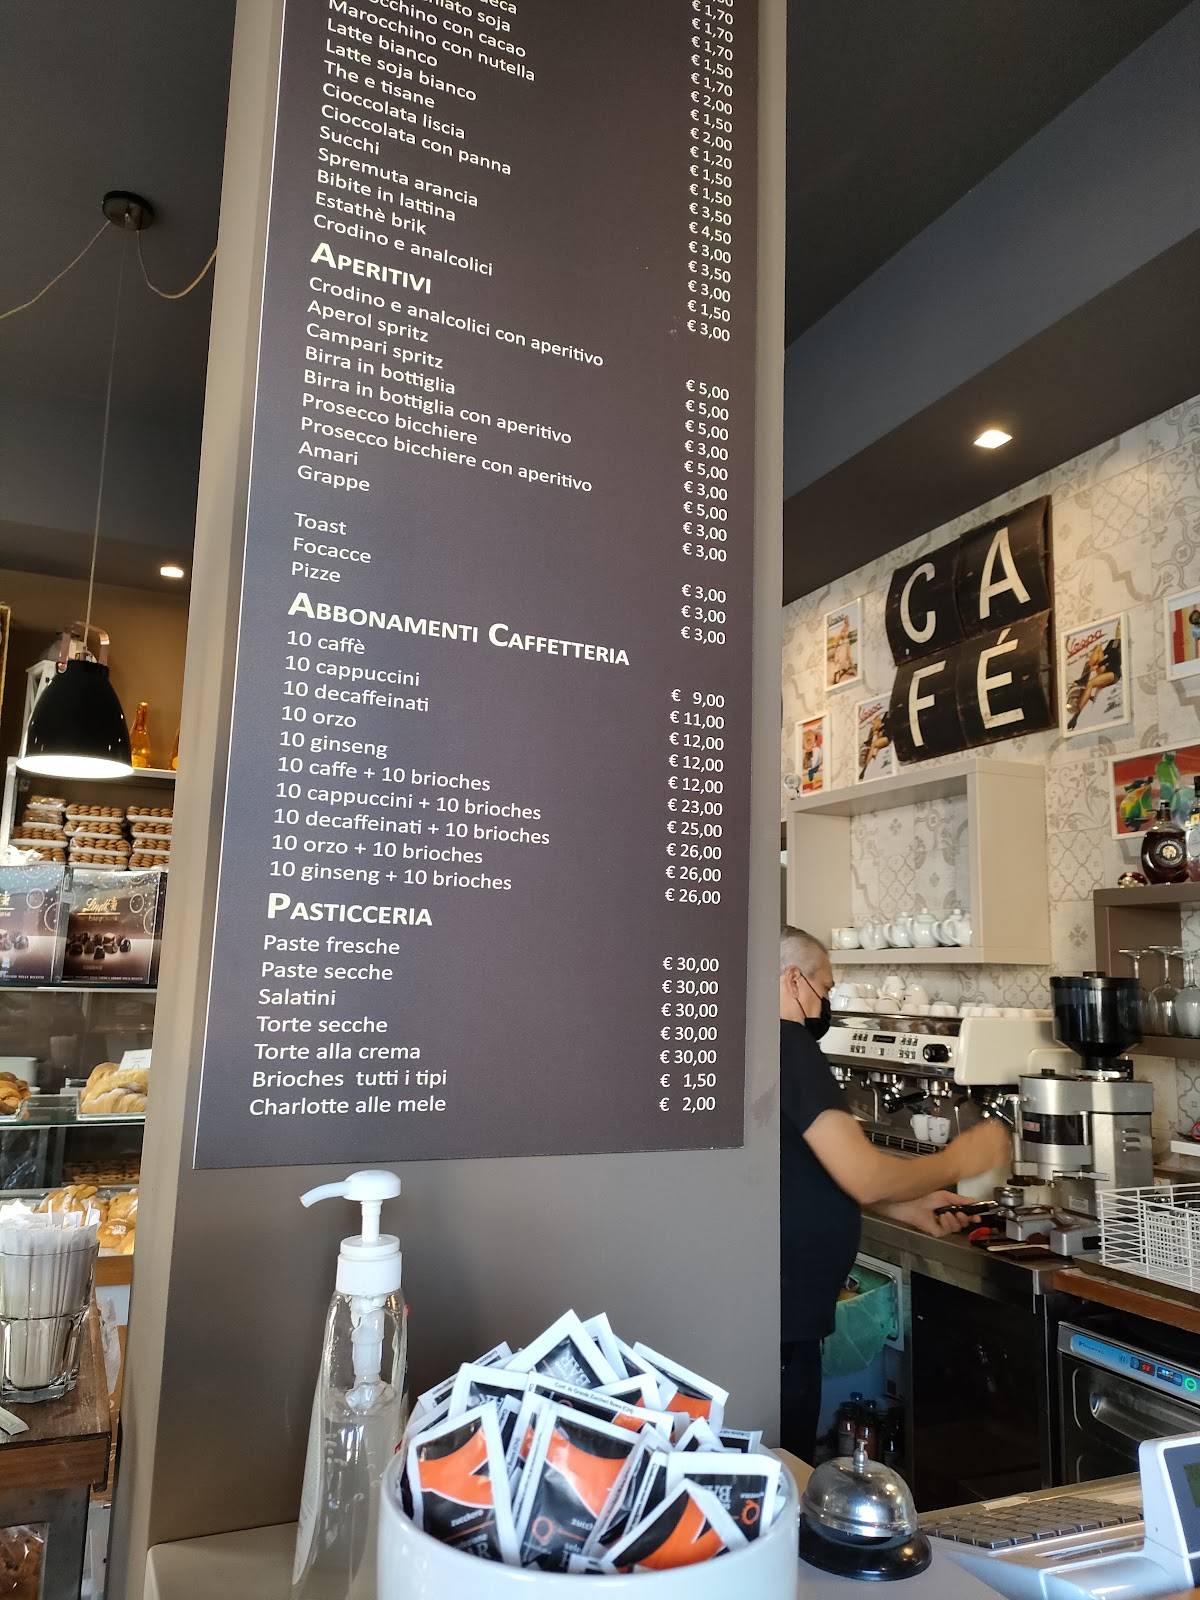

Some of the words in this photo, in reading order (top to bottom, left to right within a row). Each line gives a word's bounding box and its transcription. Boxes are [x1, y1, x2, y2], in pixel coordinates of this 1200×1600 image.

[480, 0, 517, 15] eca
[477, 12, 510, 32] soja
[692, 18, 701, 30] €
[705, 23, 733, 43] 1,70
[328, 17, 373, 44] Latte
[379, 35, 437, 67] bianco
[329, 0, 436, 45] Marocchino
[442, 40, 472, 59] con
[478, 53, 534, 81] nutella
[443, 20, 473, 39] con
[479, 33, 526, 57] cacao
[326, 39, 371, 66] Latte
[377, 60, 413, 80] soja
[419, 70, 476, 101] bianco
[691, 54, 700, 66] €
[704, 59, 733, 79] 1,50
[324, 60, 359, 83] The
[364, 77, 375, 88] e
[380, 80, 435, 108] tisane
[323, 83, 416, 124] Cioccolata
[423, 113, 464, 139] liscia
[690, 91, 700, 103] €
[703, 95, 732, 115] 2,00
[320, 126, 379, 155] Succhi
[321, 104, 415, 145] Cioccolata
[421, 139, 452, 156] con
[459, 150, 511, 175] panna
[690, 146, 699, 158] €
[703, 150, 732, 170] 1,20
[318, 147, 408, 186] Spremuta
[414, 179, 478, 207] arancia
[317, 169, 371, 196] Bibite
[378, 186, 393, 203] in
[400, 192, 455, 222] lattina
[316, 191, 385, 223] Estathè
[392, 212, 426, 235] brik
[689, 202, 698, 215] €
[702, 206, 732, 226] 3,50
[314, 214, 388, 245] Crodino
[394, 239, 405, 250] e
[410, 244, 492, 276] analcolici
[689, 221, 698, 234] €
[701, 226, 731, 245] 4,50
[307, 300, 371, 328] Aperol
[378, 320, 428, 342] spritz
[310, 277, 385, 308] Crodino
[391, 301, 401, 312] e
[407, 305, 490, 336] analcolici
[495, 329, 525, 346] con
[531, 339, 603, 366] aperitivo
[306, 323, 387, 355] Campari
[393, 347, 443, 369] spritz
[306, 346, 351, 369] Birra
[358, 358, 374, 375] in
[381, 363, 455, 395] bottiglia
[686, 379, 695, 392] €
[699, 382, 729, 401] 5,00
[303, 393, 389, 424] Prosecco
[395, 413, 477, 444] bicchiere
[304, 369, 349, 392] Birra
[356, 381, 373, 398] in
[380, 386, 454, 417] bottiglia
[460, 409, 491, 426] con
[497, 418, 571, 444] aperitivo
[298, 441, 358, 465] Amari
[301, 416, 388, 447] Prosecco
[394, 436, 476, 467] bicchiere
[482, 460, 512, 475] con
[518, 467, 592, 491] aperitivo
[684, 440, 694, 452] €
[698, 443, 728, 461] 3,00
[298, 465, 370, 491] Grappe
[294, 512, 347, 535] Toast
[293, 537, 371, 563] Focacce
[292, 561, 340, 582] Pizze
[681, 605, 691, 618] €
[694, 607, 726, 624] 3,00
[287, 630, 312, 647] 10
[318, 637, 365, 654] caffè
[285, 655, 310, 672] 10
[316, 663, 419, 686] cappuccini
[284, 681, 308, 697] 10
[315, 684, 429, 712] decaffeinati
[671, 689, 681, 702] €
[693, 692, 725, 708] 9,00
[282, 706, 306, 722] 10
[313, 713, 356, 727] orzo
[670, 710, 680, 723] €
[684, 712, 724, 729] 11,00
[280, 731, 305, 747] 10
[310, 735, 388, 759] ginseng
[278, 757, 303, 773] 10
[309, 761, 357, 778] caffe
[364, 768, 375, 779] +
[382, 767, 405, 783] 10
[411, 769, 490, 791] brioches
[276, 782, 301, 799] 10
[307, 789, 413, 808] cappuccini
[419, 798, 430, 809] +
[437, 797, 459, 812] 10
[465, 798, 541, 820] brioches
[667, 798, 677, 811] €
[682, 799, 723, 816] 23,00
[274, 808, 299, 824] 10
[306, 810, 422, 834] decaffeinati
[428, 824, 439, 834] +
[446, 822, 468, 838] 10
[474, 824, 549, 844] brioches
[272, 834, 297, 850] 10
[304, 840, 348, 854] orzo
[354, 843, 366, 854] +
[373, 842, 396, 857] 10
[403, 843, 483, 863] brioches
[270, 861, 295, 877] 10
[301, 863, 380, 885] ginseng
[385, 871, 397, 882] +
[404, 869, 427, 885] 10
[433, 870, 511, 890] brioches
[665, 865, 676, 879] €
[680, 866, 721, 883] 26,00
[264, 935, 320, 952] Paste
[326, 936, 400, 954] fresche
[262, 962, 318, 978] Paste
[324, 964, 393, 980] secche
[258, 988, 336, 1005] Salatini
[661, 1003, 671, 1017] €
[675, 1003, 718, 1020] 30,00
[256, 1016, 312, 1032] Torte
[318, 1016, 388, 1033] secche
[254, 1044, 309, 1059] Torte
[316, 1043, 352, 1059] alla
[359, 1047, 420, 1059] crema
[253, 1070, 344, 1087] Brioches
[356, 1070, 398, 1086] tutti
[415, 1069, 447, 1089] tipi
[660, 1073, 670, 1087] €
[684, 1073, 716, 1090] 1,50
[250, 1097, 349, 1115] Charlotte
[355, 1096, 391, 1113] alle
[398, 1095, 446, 1112] mele
